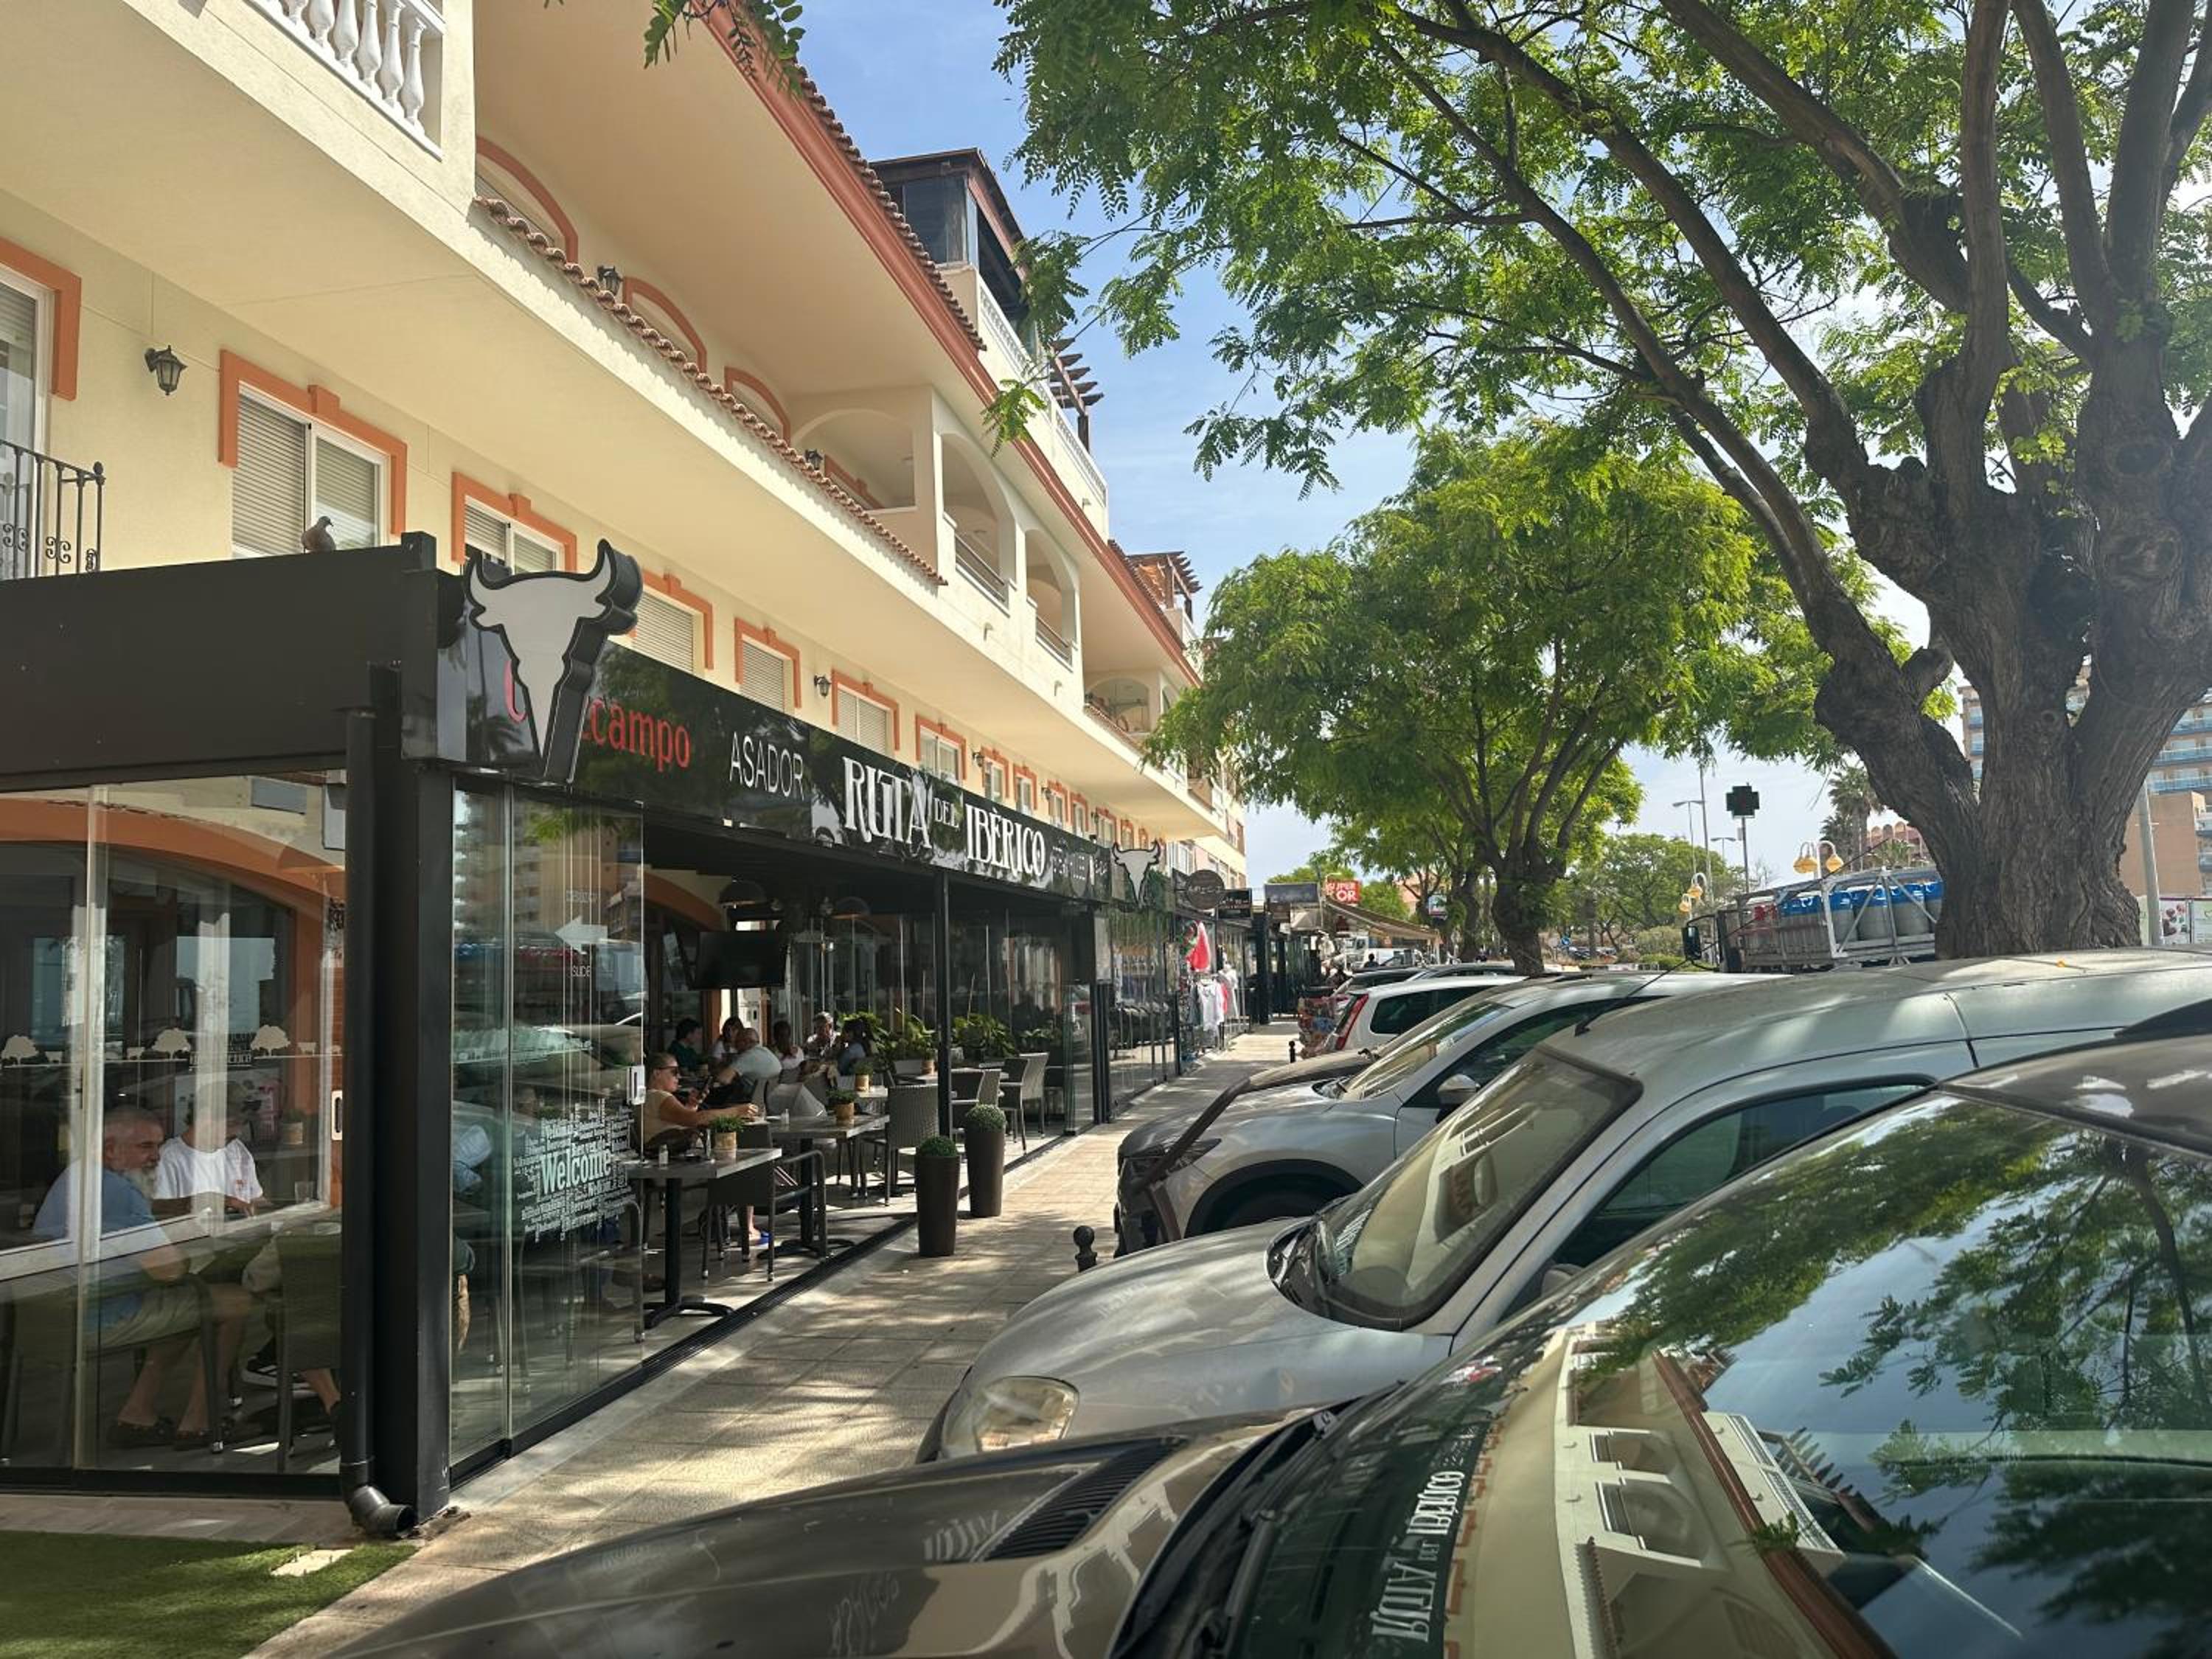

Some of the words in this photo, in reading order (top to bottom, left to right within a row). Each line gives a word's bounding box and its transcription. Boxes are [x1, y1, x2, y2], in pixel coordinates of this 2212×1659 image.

[729, 731, 804, 801] ASADOR
[842, 756, 933, 849] RUTA
[932, 797, 959, 829] DEL
[540, 1148, 611, 1195] Welcome
